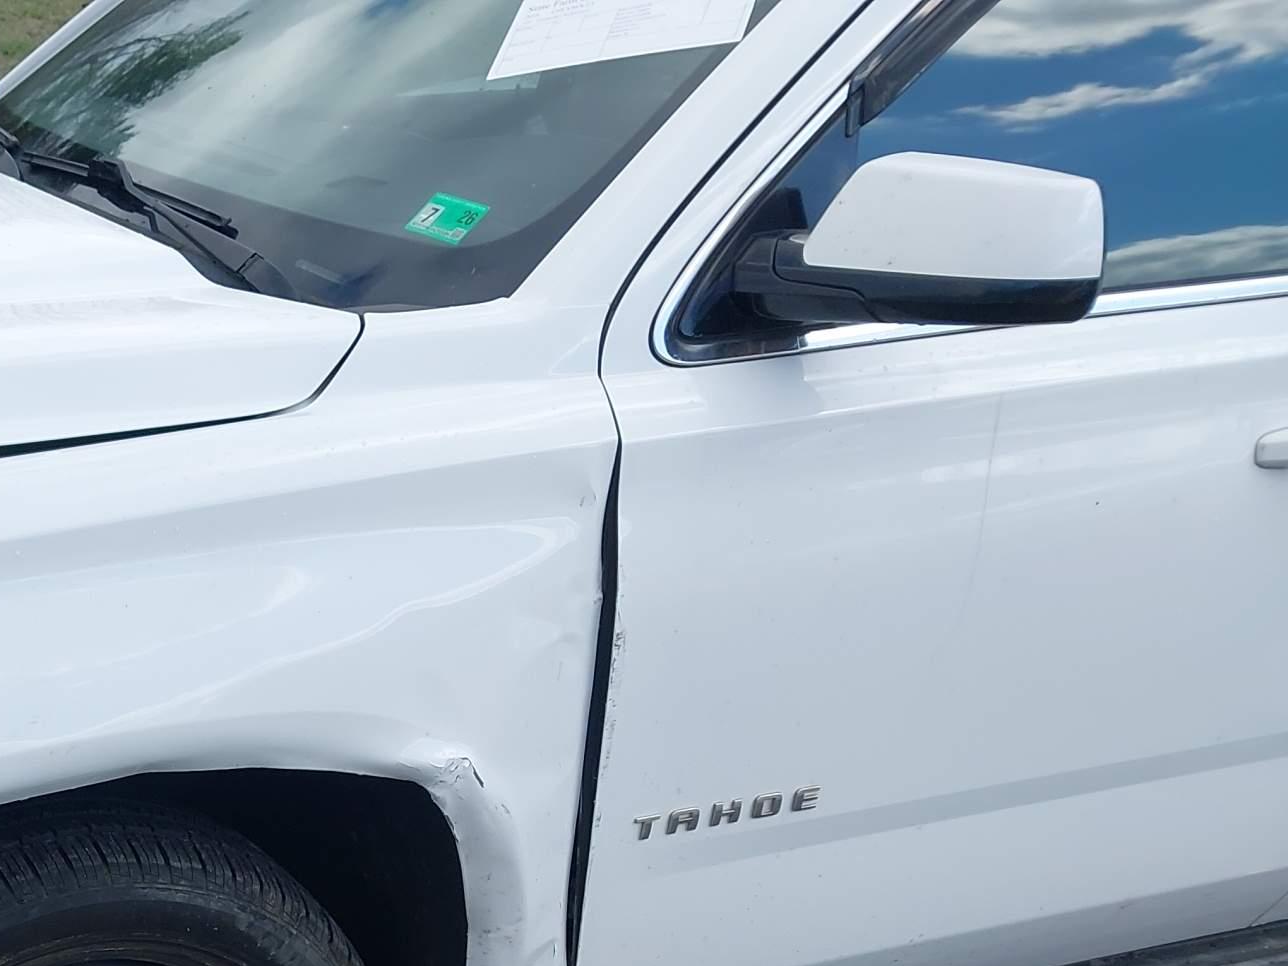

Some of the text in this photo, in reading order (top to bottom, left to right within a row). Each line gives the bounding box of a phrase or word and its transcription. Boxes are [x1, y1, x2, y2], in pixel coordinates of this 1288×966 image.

[420, 207, 479, 226] 7 26
[633, 784, 821, 841] TAHOE
